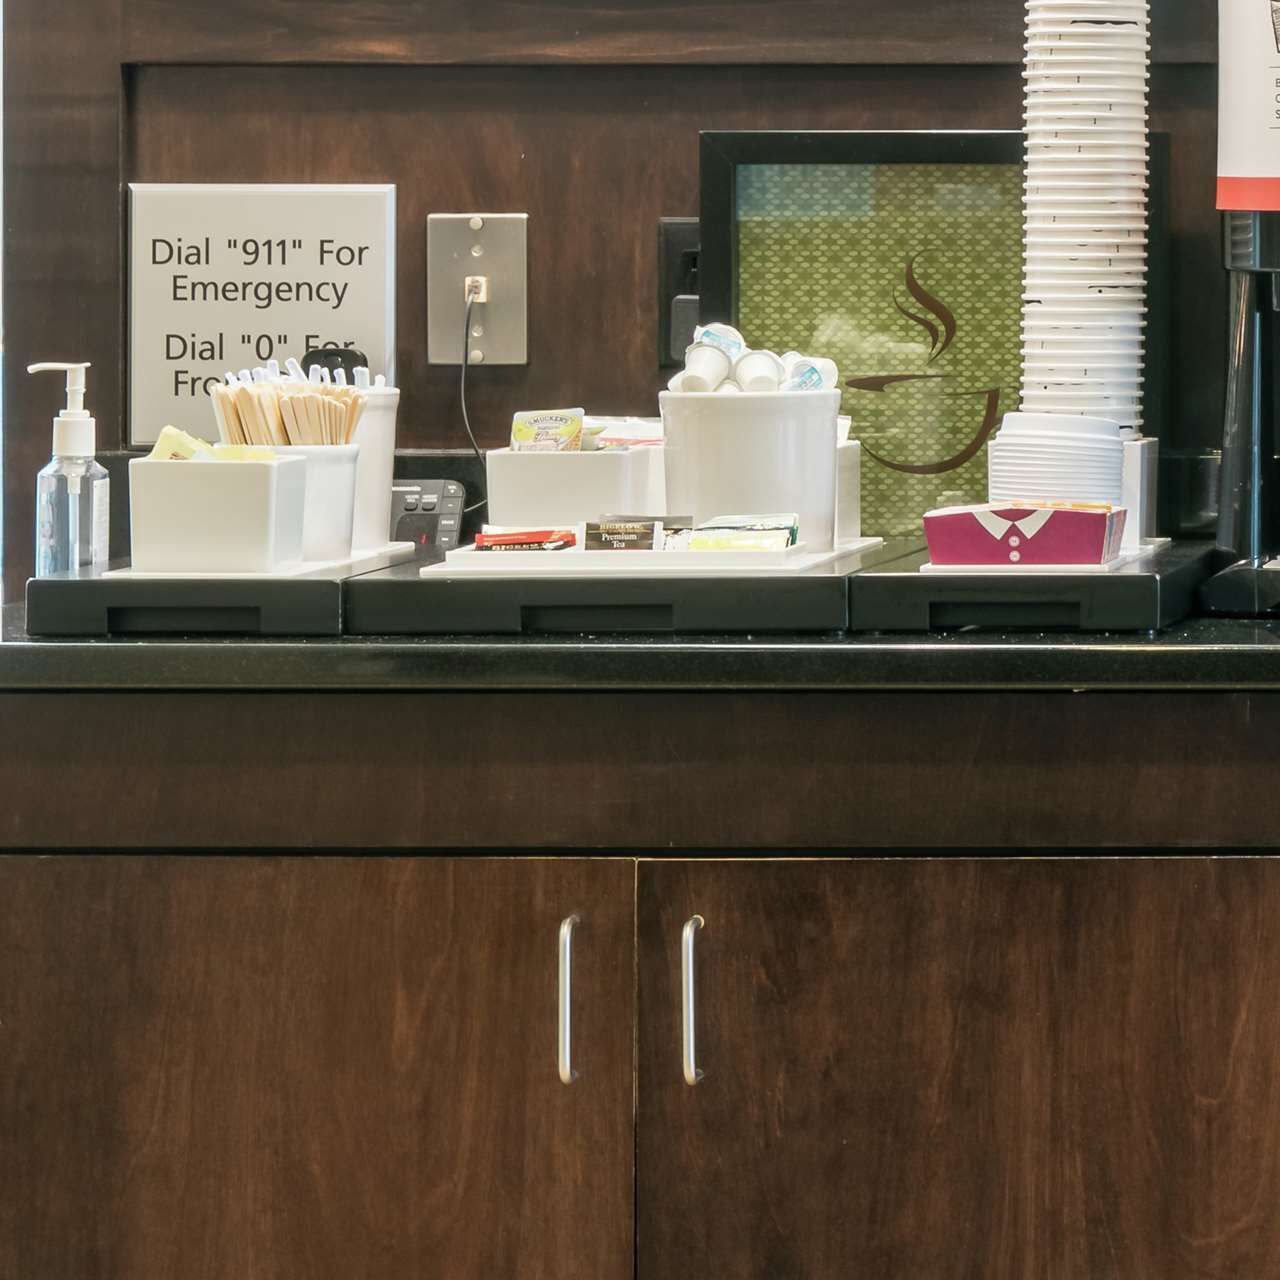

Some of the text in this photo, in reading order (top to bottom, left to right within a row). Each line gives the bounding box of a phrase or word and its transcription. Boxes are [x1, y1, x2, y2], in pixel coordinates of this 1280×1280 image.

[151, 238, 369, 266] Dial "911" For
[172, 275, 348, 309] Emergency
[165, 333, 223, 361] Dial
[241, 334, 288, 362] "0"
[602, 533, 637, 541] Premium
[612, 541, 625, 549] Tea
